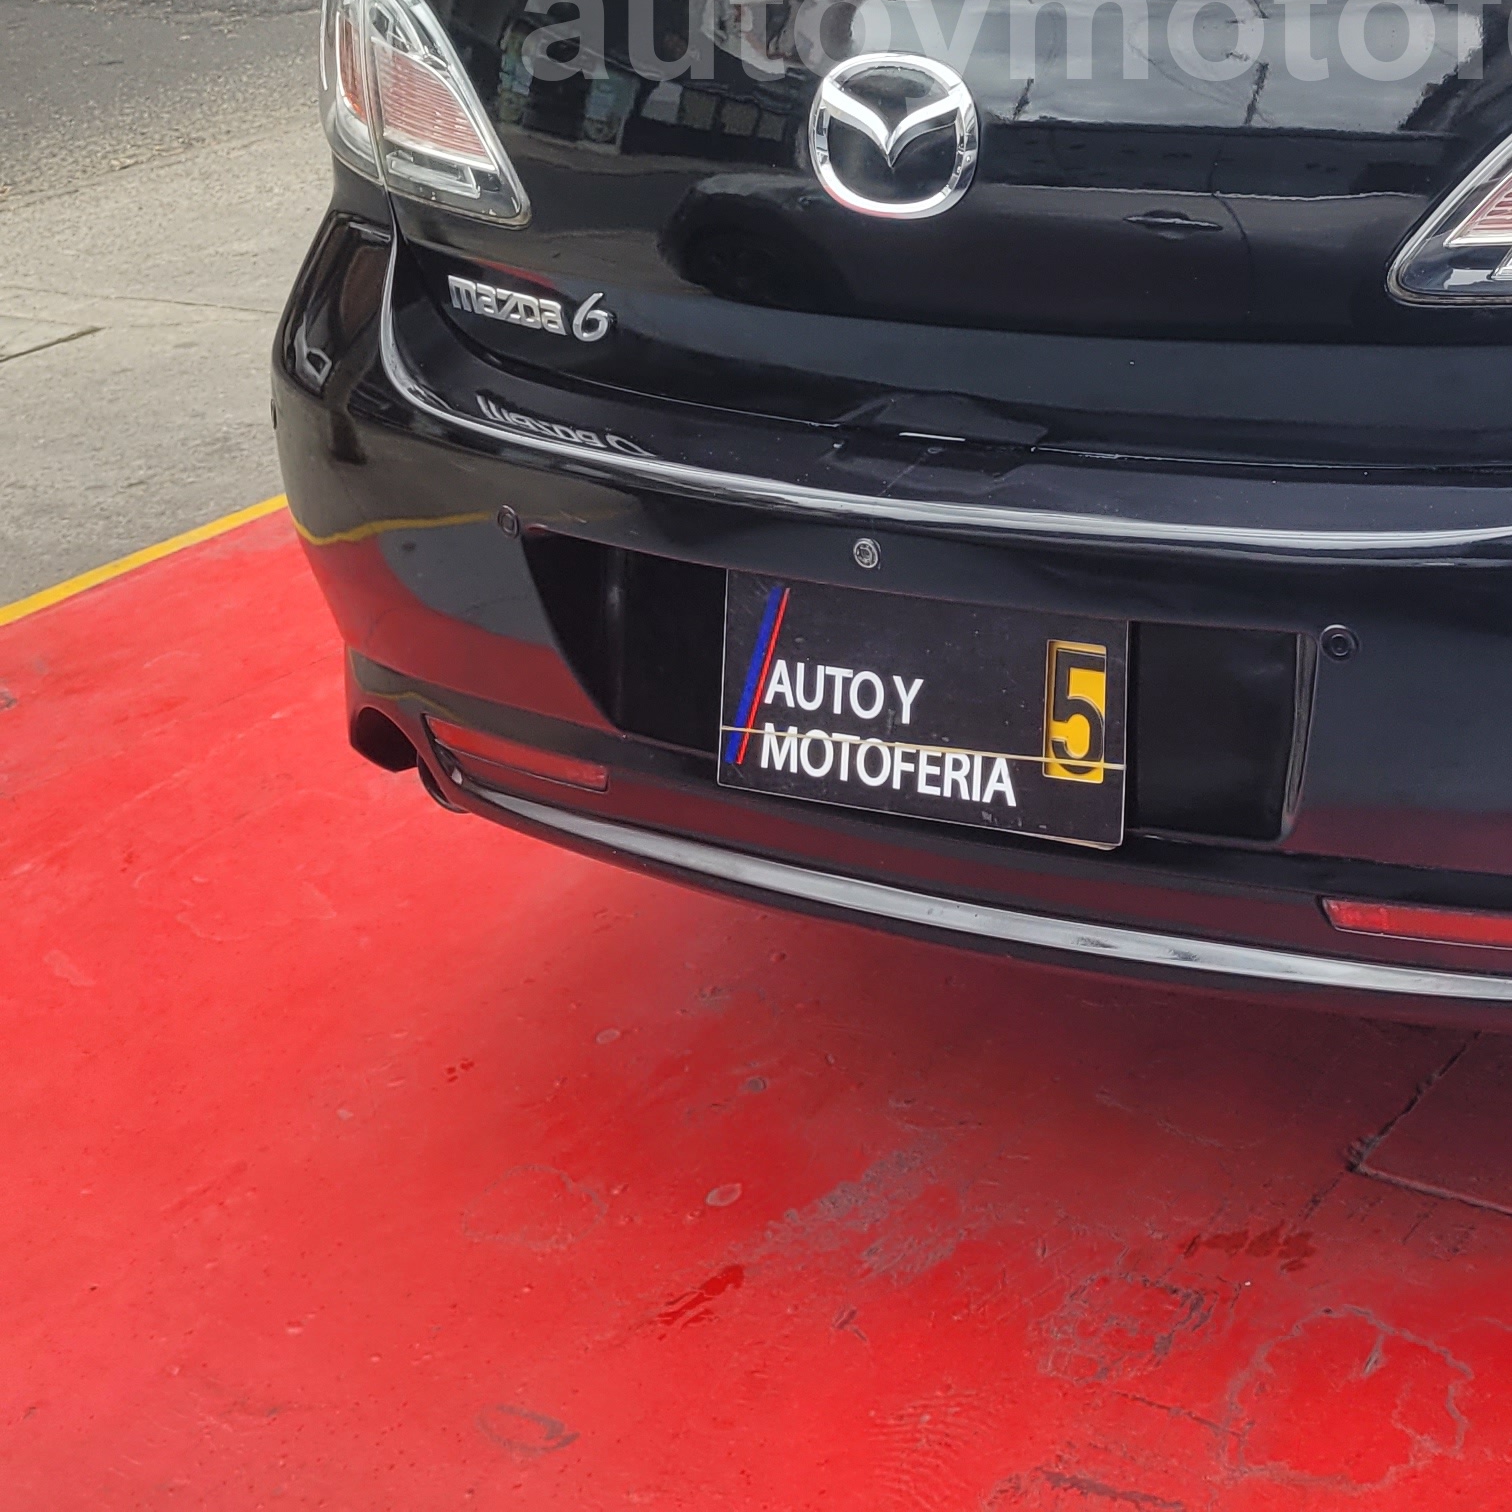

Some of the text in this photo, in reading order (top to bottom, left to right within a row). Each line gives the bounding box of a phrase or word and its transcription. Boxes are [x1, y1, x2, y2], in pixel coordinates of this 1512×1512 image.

[572, 292, 611, 343] 6
[763, 659, 924, 724] AUTO Y
[1051, 647, 1106, 775] 5
[760, 722, 1017, 808] MOTOFERIA
